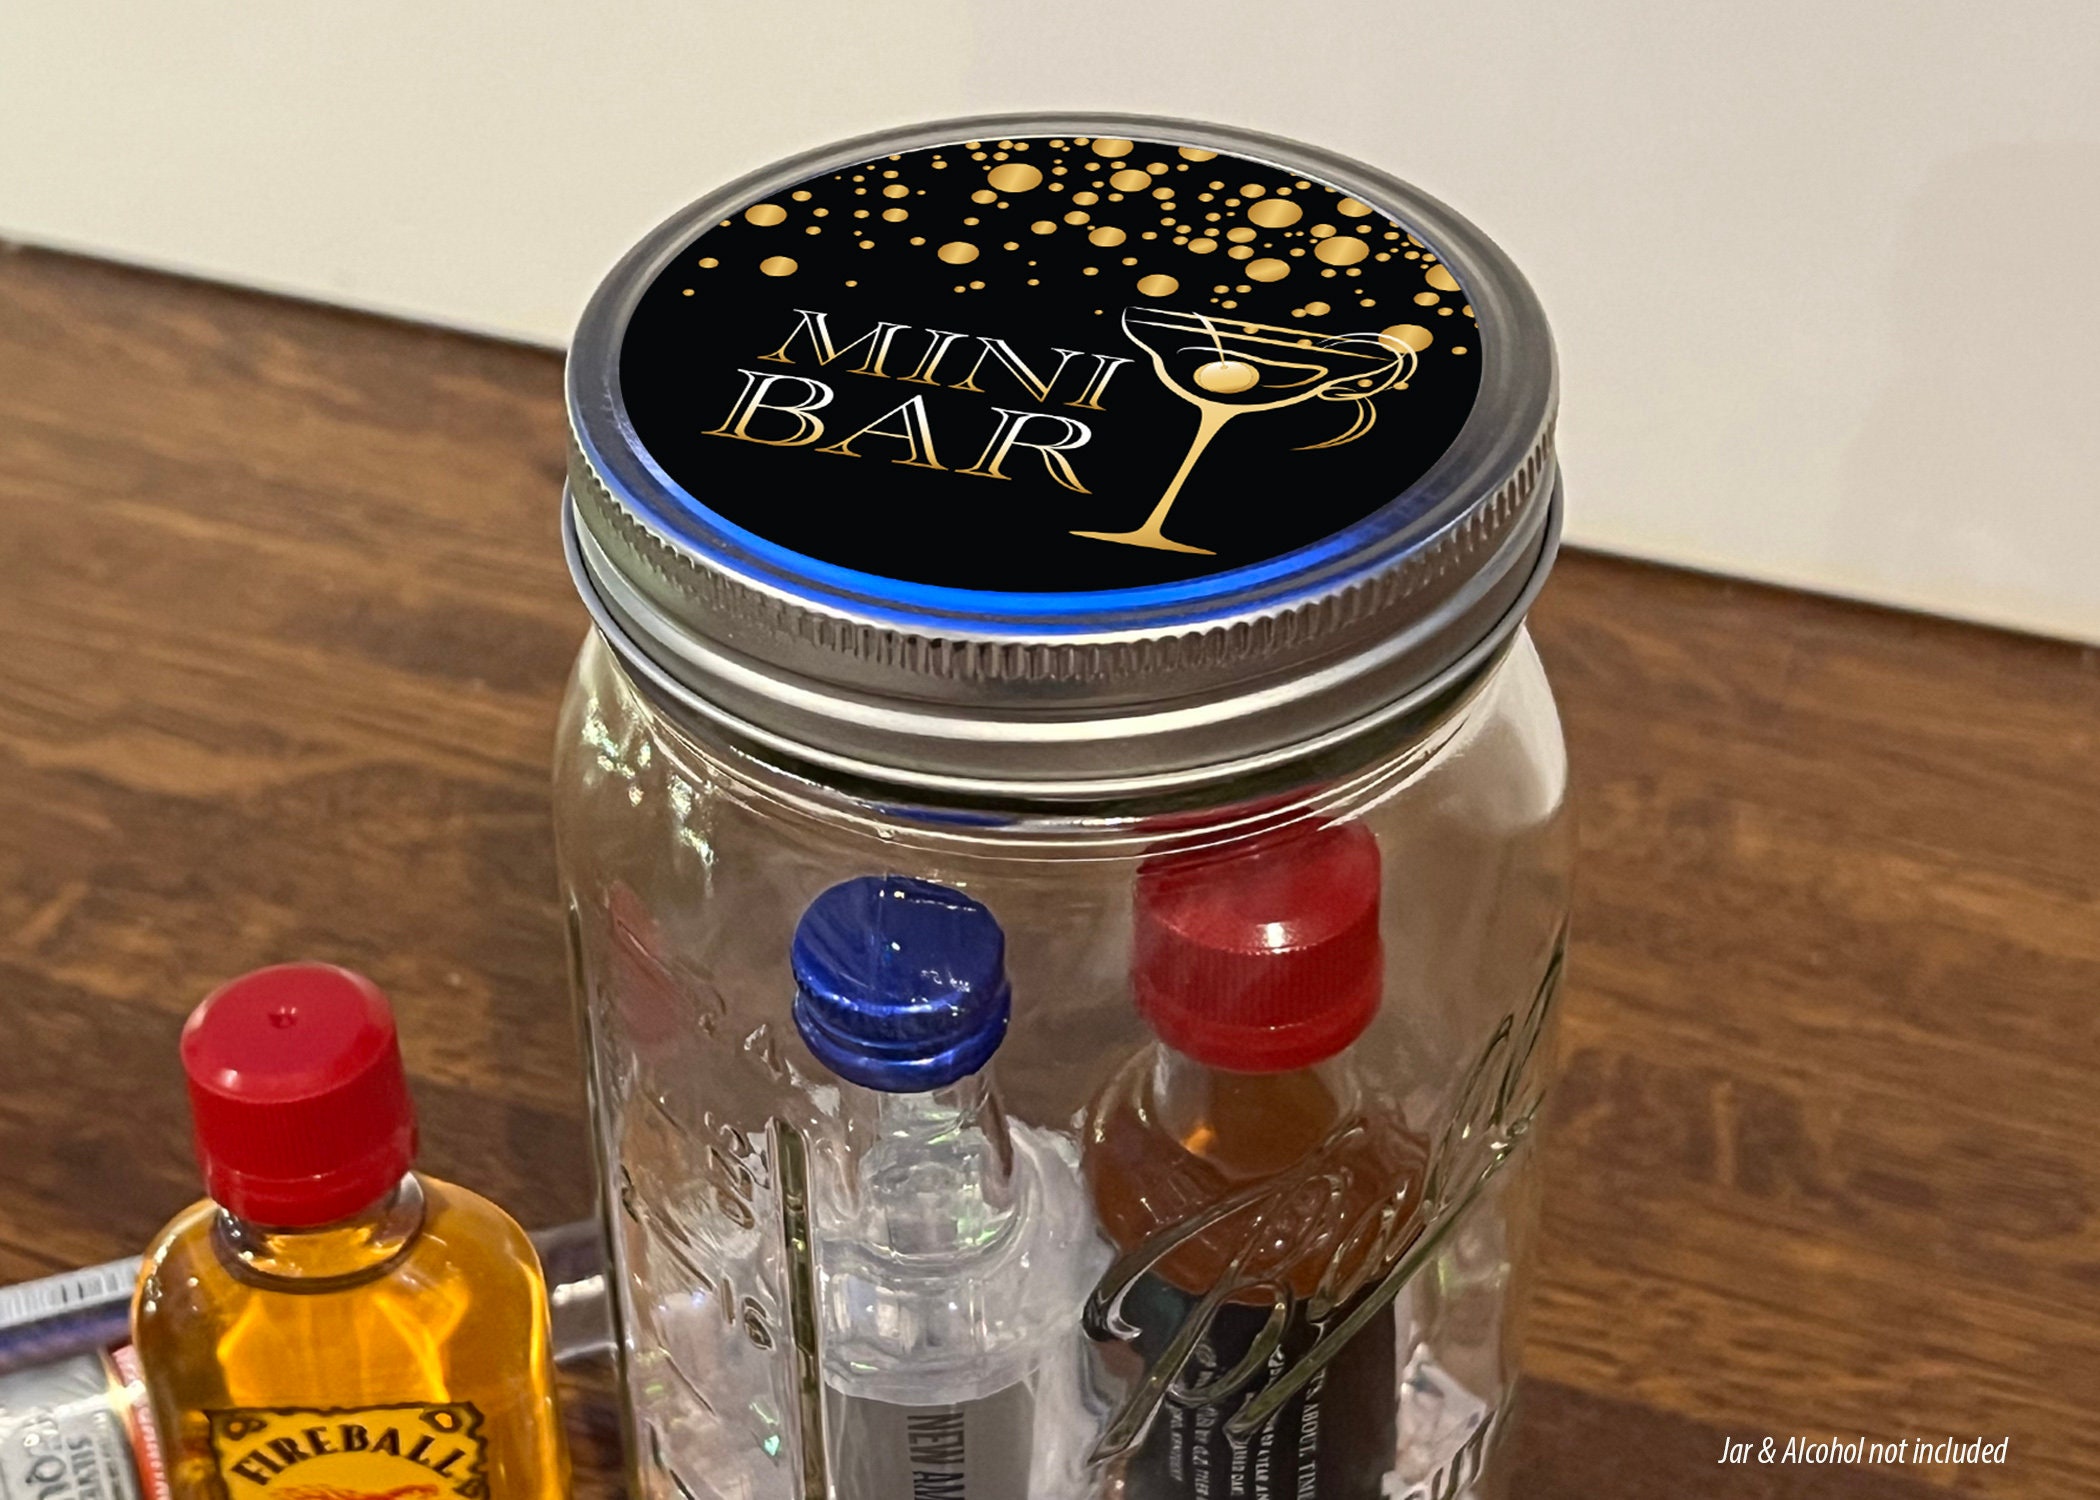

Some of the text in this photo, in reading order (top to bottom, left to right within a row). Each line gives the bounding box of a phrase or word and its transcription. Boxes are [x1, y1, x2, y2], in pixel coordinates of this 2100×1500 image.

[757, 308, 1135, 411] MINI
[701, 368, 1093, 495] BAR
[230, 1424, 466, 1486] FIREBALL
[907, 1412, 965, 1464] NEW
